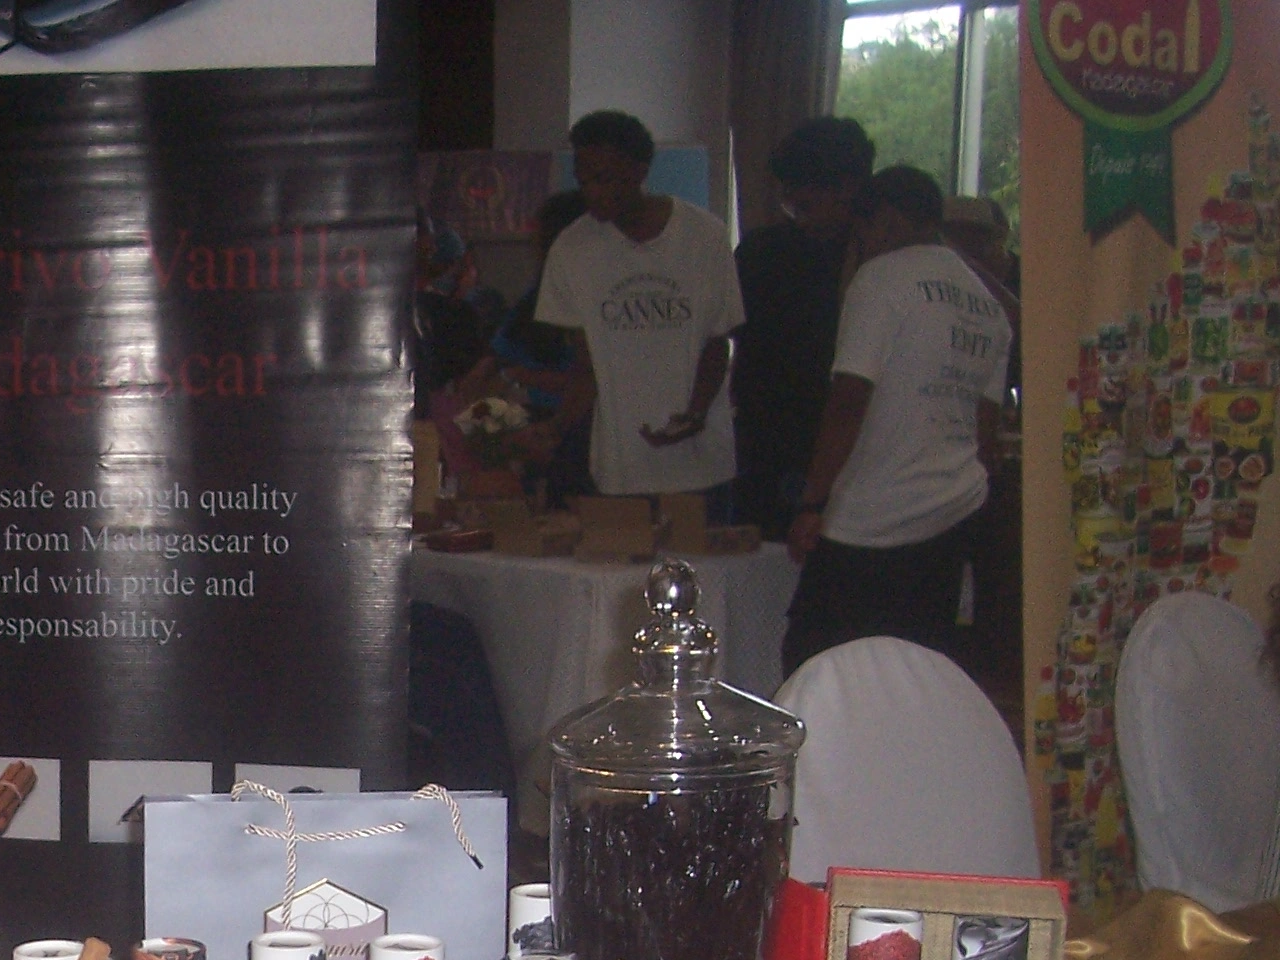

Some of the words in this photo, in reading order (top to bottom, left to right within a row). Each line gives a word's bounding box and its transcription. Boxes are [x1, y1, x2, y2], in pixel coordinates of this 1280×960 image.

[1048, 0, 1200, 72] Codal
[140, 225, 368, 292] Vanilla
[0, 482, 54, 509] safe
[200, 483, 297, 517] quality
[4, 525, 69, 551] from
[81, 525, 253, 559] Madagascar
[262, 530, 289, 556] to
[49, 569, 110, 595] with
[120, 569, 195, 598] pride
[205, 571, 255, 597] and
